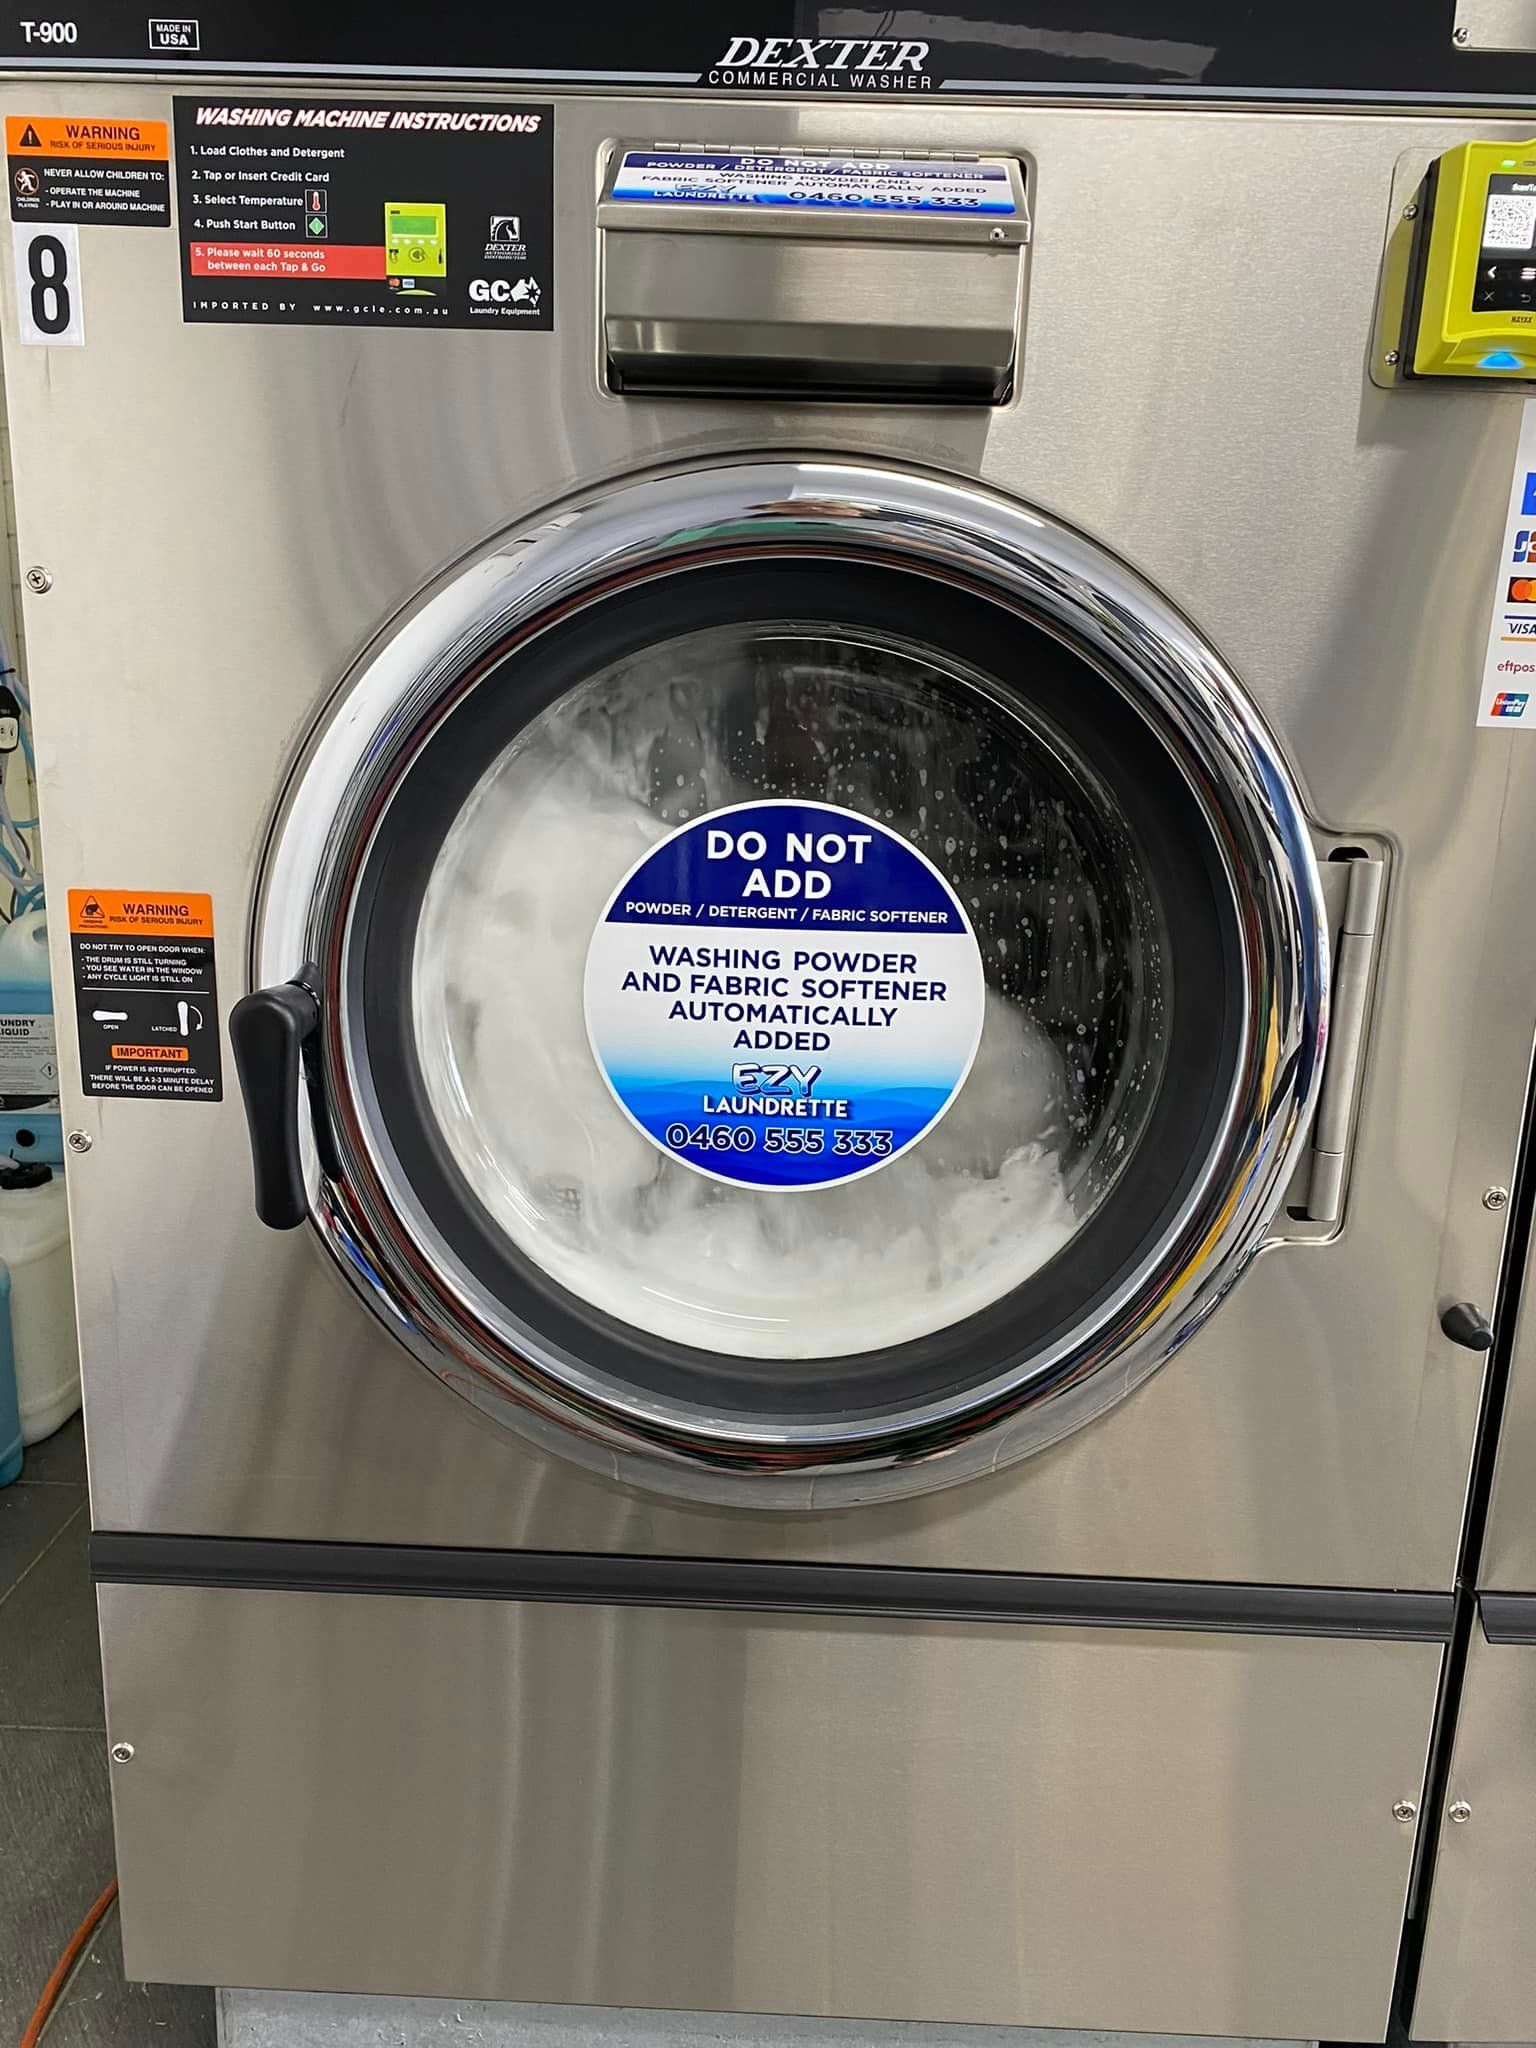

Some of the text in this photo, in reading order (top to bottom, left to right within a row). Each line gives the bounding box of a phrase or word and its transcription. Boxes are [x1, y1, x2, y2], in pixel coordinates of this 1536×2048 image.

[20, 22, 77, 43] T-900
[156, 24, 191, 33] MADE IN
[160, 34, 189, 45] USA
[715, 37, 930, 71] DEXTER
[708, 71, 932, 89] COMMERCIAL WASHER
[196, 107, 541, 133] WASHING MACHINE INSTRUCTIONS
[66, 125, 140, 140] WARNING
[50, 140, 155, 152] RISK OF SERIOUS INJURY
[190, 145, 345, 160] 1. Load Clothes and Detergent
[647, 162, 984, 179] POWDER DETERGENT FABRIC SOFTENER
[741, 158, 890, 170] DO NOT ADD
[44, 168, 165, 181] NEVER ALLOW CHILDREN TO:
[191, 170, 330, 182] 2. Tap or Insert Credit Card
[720, 172, 794, 180] WASHING
[800, 175, 869, 183] POWDER
[642, 175, 987, 194] FABRIC SOFTENER AUTOMATICALLY ADDED
[50, 187, 141, 198] OPERATE THE MACHINE
[654, 191, 754, 201] LAUNDRETTE
[788, 191, 980, 207] 0460 555 333
[50, 201, 71, 209] PLAY
[82, 202, 94, 210] OR
[95, 202, 129, 211] AROUND
[130, 203, 165, 212] MACHINE
[193, 194, 304, 208] 3. Select Temperature
[193, 219, 296, 230] 4. Push Start Button
[195, 247, 325, 259] 5. Please wait 60 seconds
[484, 243, 526, 252] DEXTER
[208, 260, 326, 273] between each Tap & Go
[28, 234, 70, 335] 8
[193, 301, 296, 311] IMPORTED BY
[470, 306, 540, 316] Laundry Equipment
[1507, 623, 1536, 635] VISA
[707, 830, 872, 864] DO NOT
[742, 868, 832, 899] ADD
[123, 903, 189, 916] WARNING
[625, 901, 948, 925] POWDER / DETERGENT / FABRIC SOFTENER
[141, 917, 174, 925] SERIOUS
[176, 918, 203, 926] INJURY
[92, 943, 107, 951] NOT
[133, 957, 152, 965] STILL
[154, 958, 187, 966] TURNING
[649, 945, 917, 975] WASHING POWDER
[103, 965, 117, 973] SEE
[147, 966, 154, 974] IN
[171, 967, 203, 975] WINDOW
[181, 976, 193, 984] ON
[621, 971, 947, 1002] AND FABRIC SOFTENER
[668, 1001, 898, 1028] AUTOMATICALLY
[733, 1029, 831, 1052] ADDED
[117, 1047, 183, 1059] IMPORTANT
[163, 1077, 189, 1085] MINUTE
[191, 1078, 214, 1086] DELAY
[731, 1062, 822, 1097] EZY
[185, 1086, 213, 1094] OPENED
[703, 1095, 849, 1118] LAUNDRETTE
[666, 1123, 894, 1156] 0460 555 333
